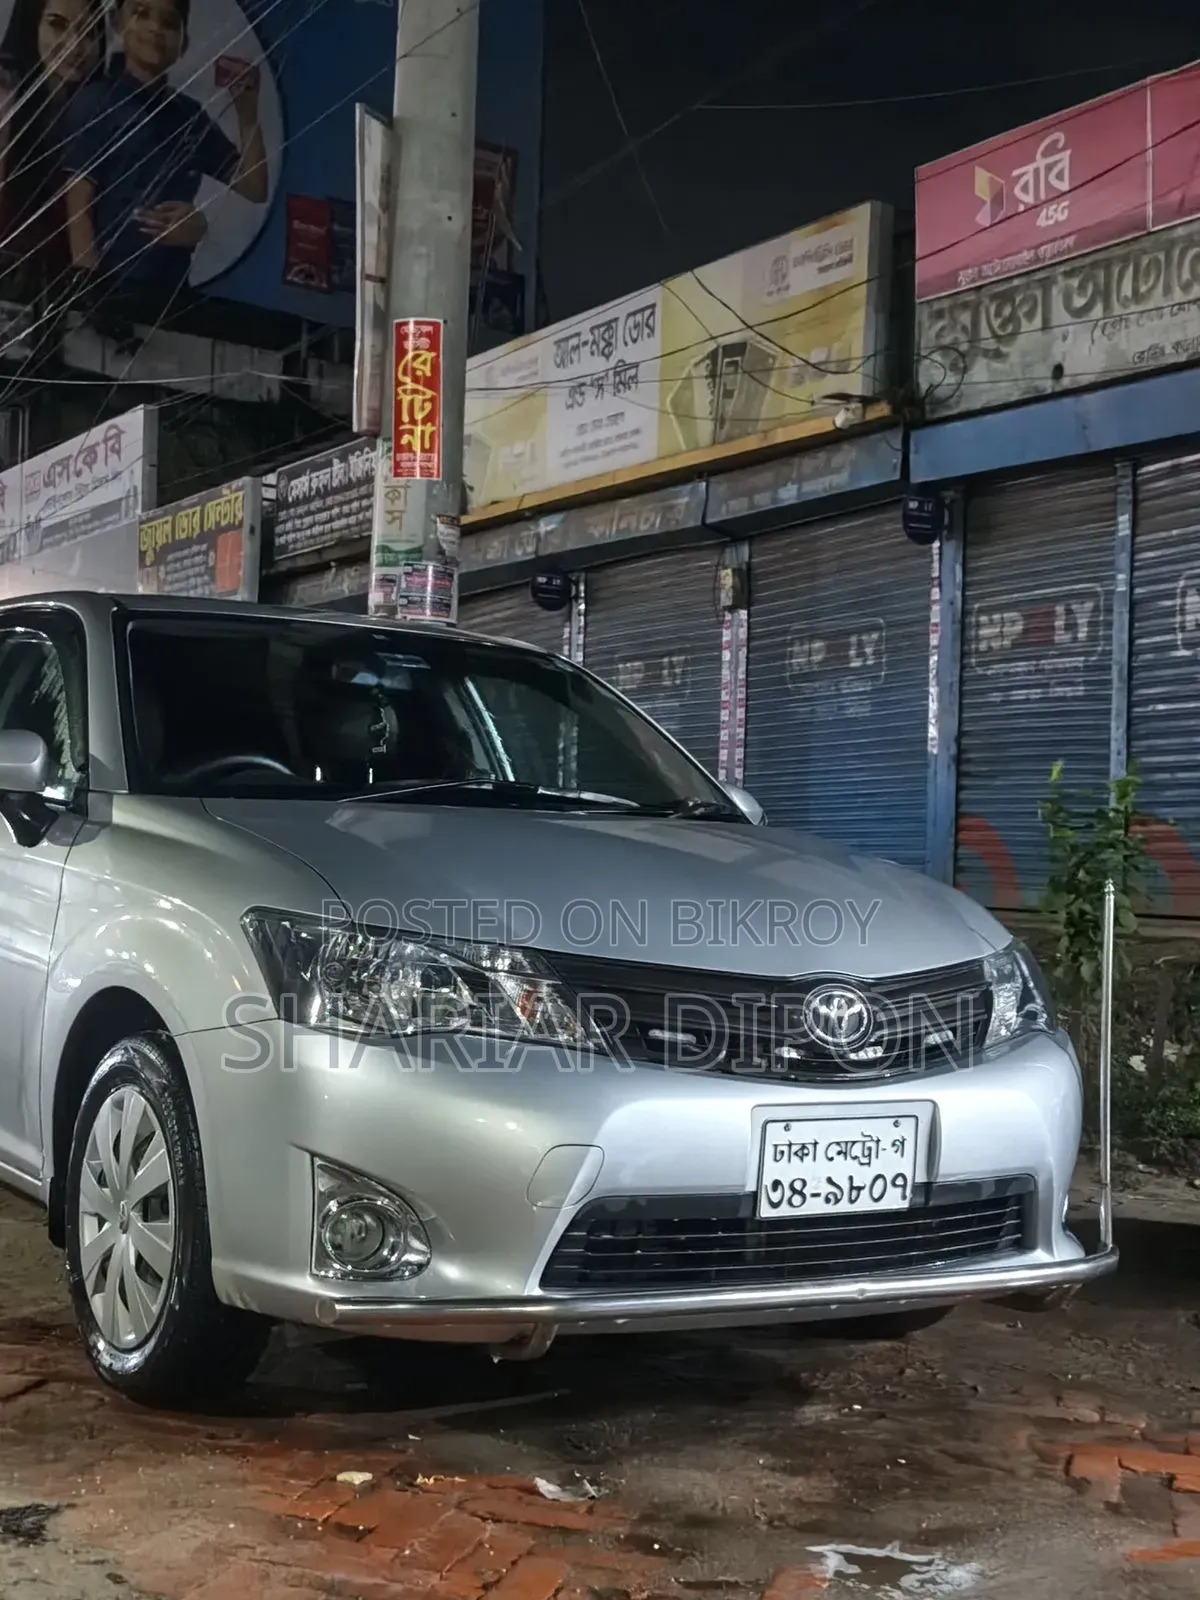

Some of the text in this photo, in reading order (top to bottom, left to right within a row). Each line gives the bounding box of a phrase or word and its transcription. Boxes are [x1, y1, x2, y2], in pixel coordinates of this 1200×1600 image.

[1011, 131, 1072, 213] রবি
[623, 302, 657, 349] ডোর
[612, 358, 641, 398] মিল
[771, 1138, 819, 1164] ঢাকা
[764, 1171, 909, 1210] ৩৪-৯৮০৭
